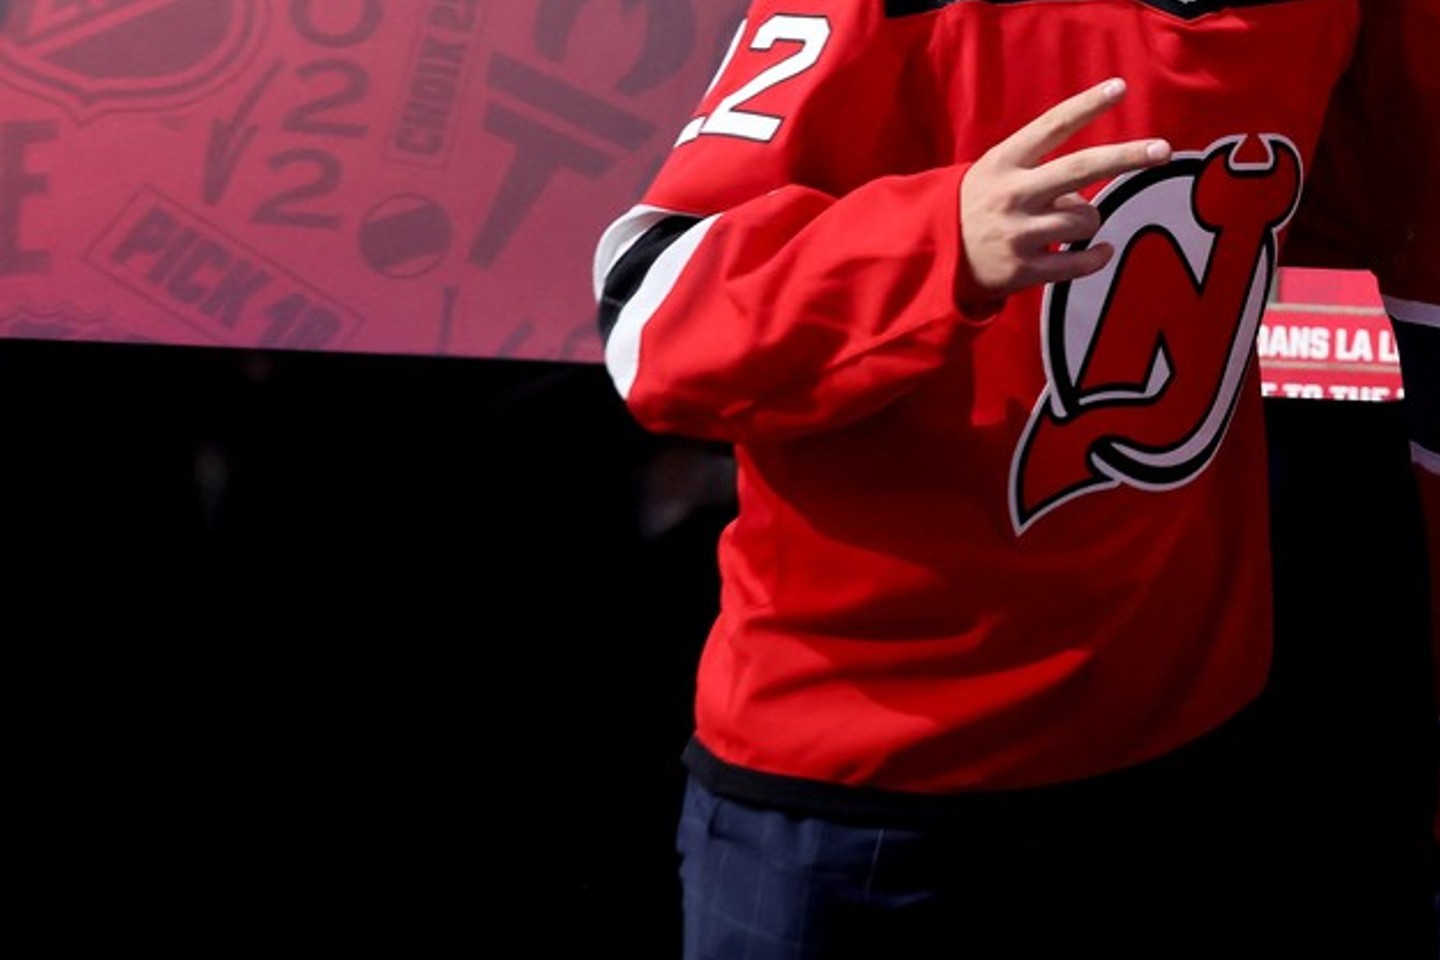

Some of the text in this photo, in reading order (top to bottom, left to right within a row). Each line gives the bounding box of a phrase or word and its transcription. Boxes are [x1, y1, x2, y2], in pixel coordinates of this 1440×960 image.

[396, 37, 467, 155] CHOIX
[672, 14, 832, 149] 2
[110, 206, 272, 330] PICK
[1335, 327, 1373, 361] LA
